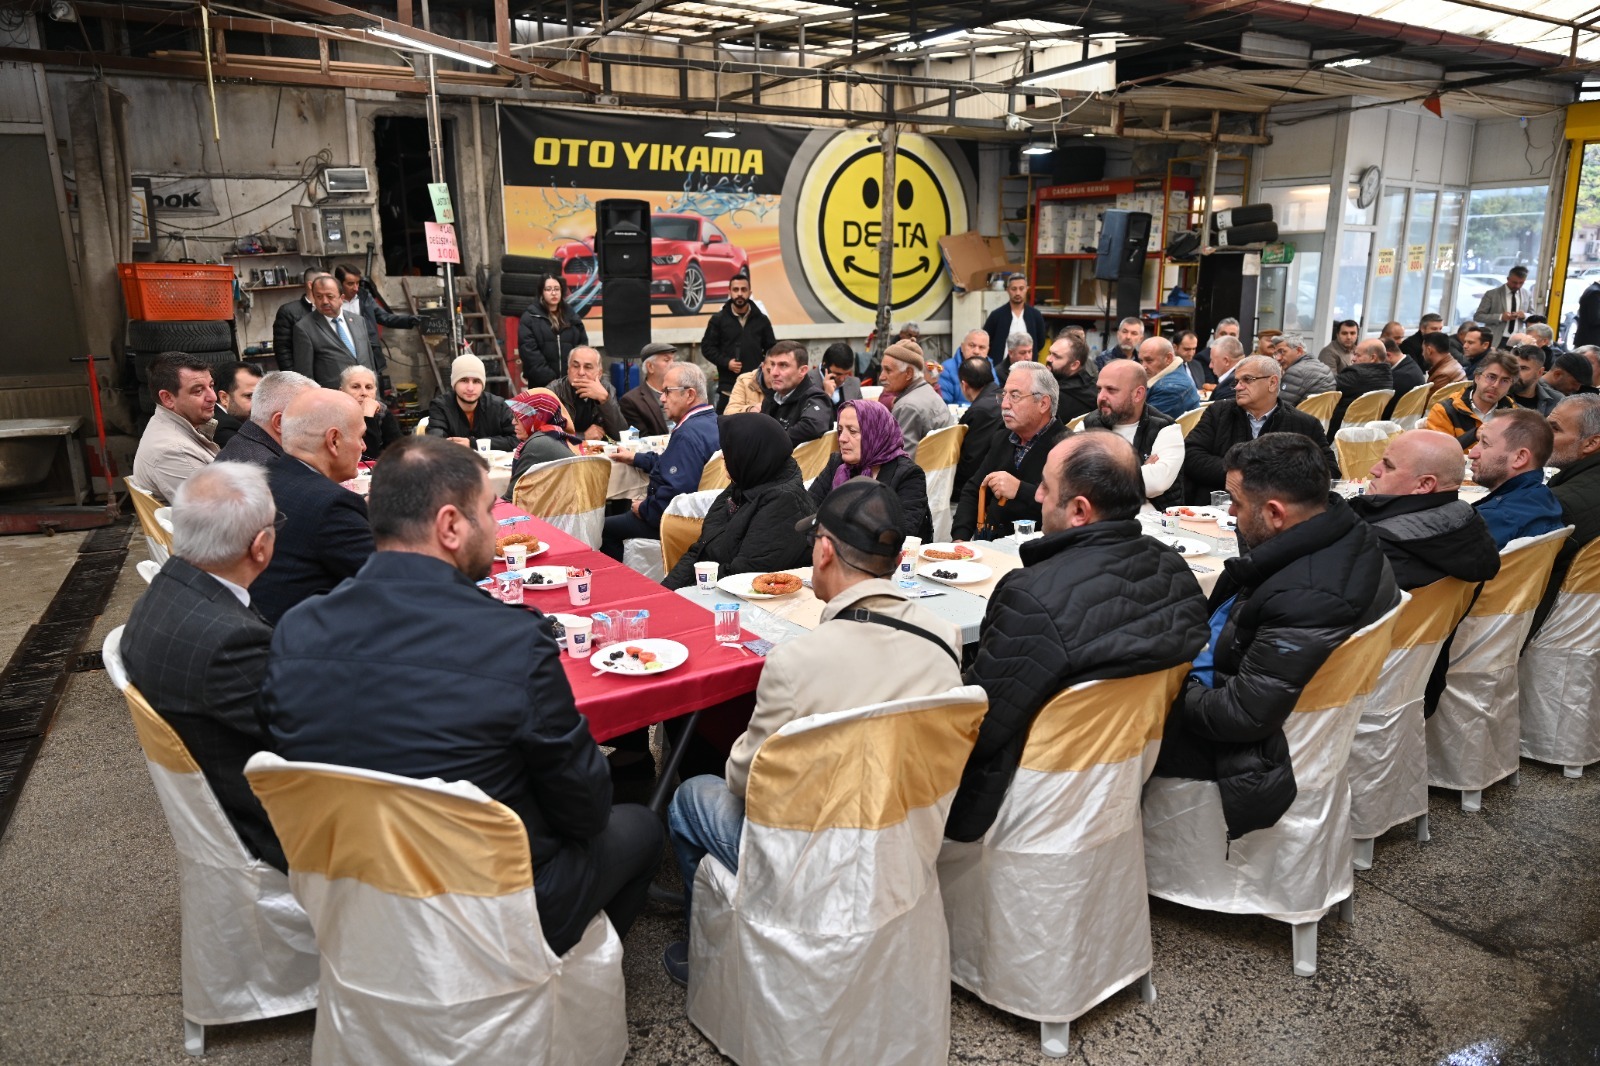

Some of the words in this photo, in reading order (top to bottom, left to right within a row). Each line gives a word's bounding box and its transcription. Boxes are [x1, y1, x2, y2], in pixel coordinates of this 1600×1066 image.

[533, 137, 615, 168] OTO
[621, 142, 764, 175] YIKAMA
[843, 220, 929, 248] DETA
